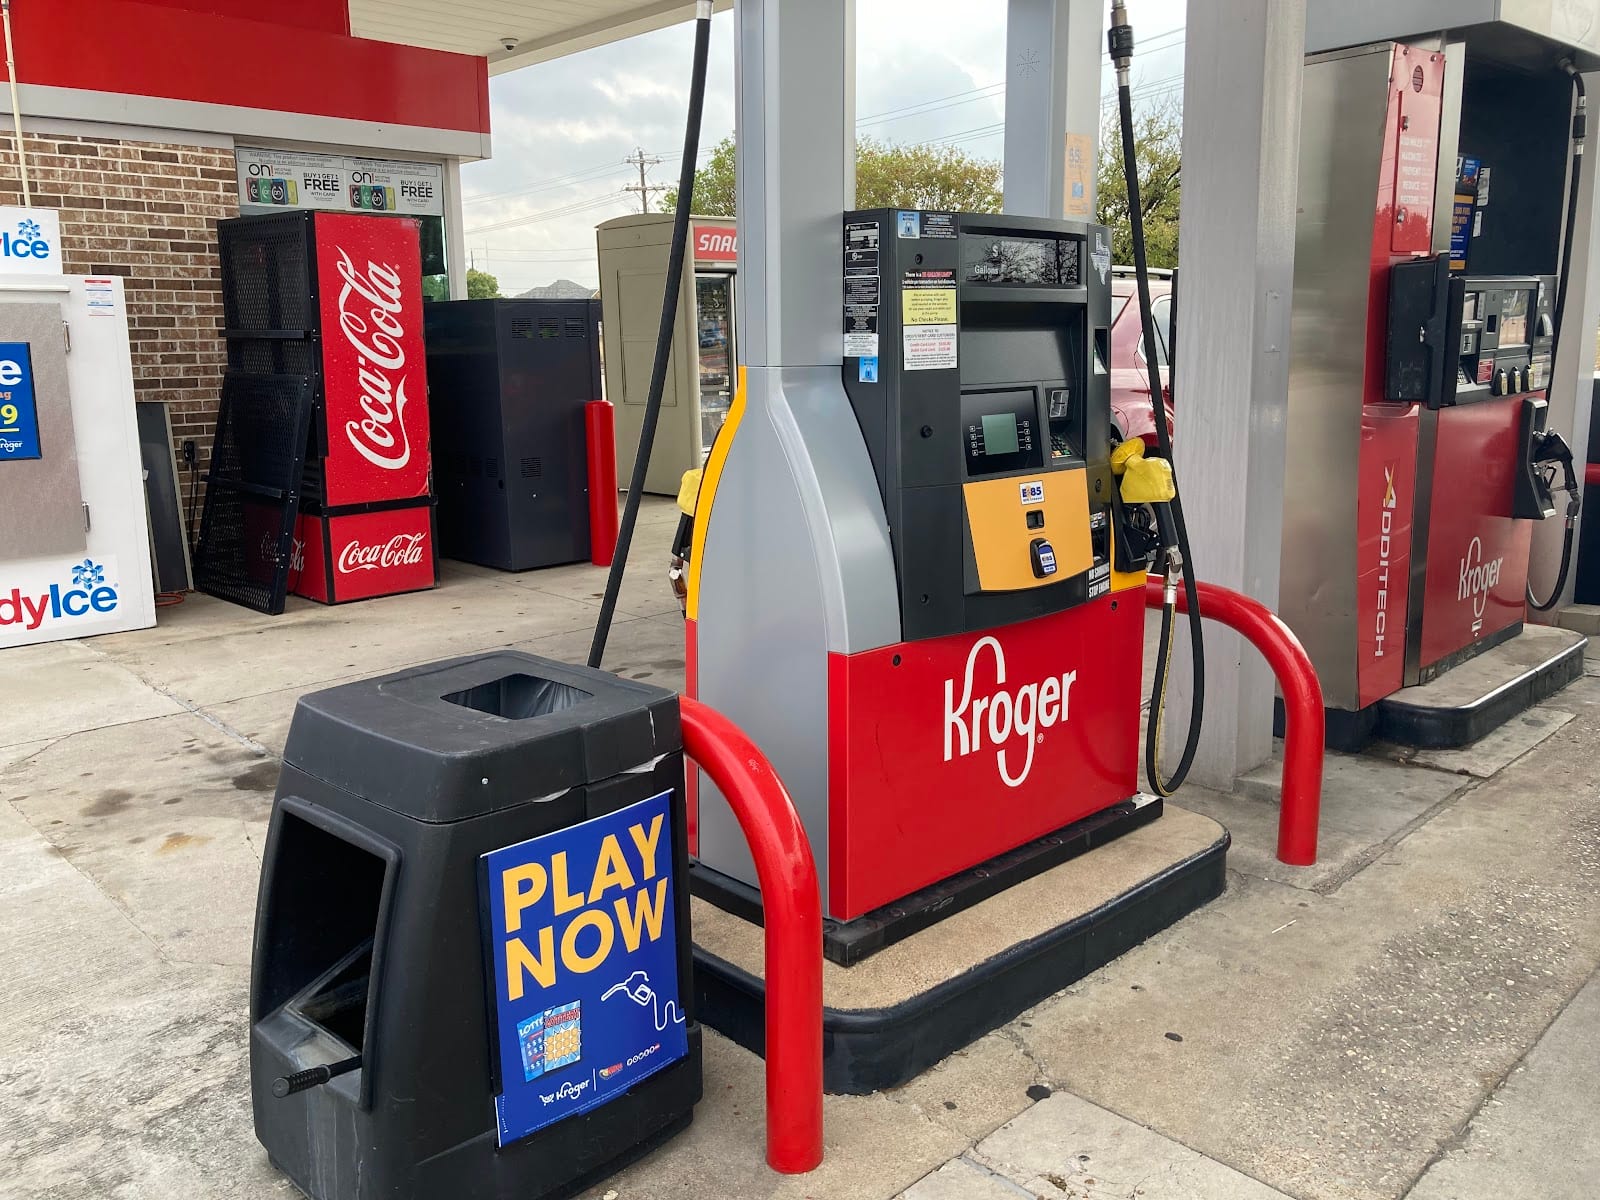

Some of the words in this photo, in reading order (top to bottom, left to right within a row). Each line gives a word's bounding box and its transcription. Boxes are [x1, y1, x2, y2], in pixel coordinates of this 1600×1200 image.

[303, 178, 340, 192] FREE
[401, 186, 433, 198] FREE
[0, 232, 50, 259] Ice
[974, 264, 999, 275] Gallons
[336, 244, 410, 470] Coca-Cola
[0, 438, 23, 453] roger
[338, 531, 427, 574] Coca-Cola
[1374, 464, 1397, 657] ADDITECH
[1088, 584, 1099, 598] STOP
[1098, 578, 1110, 594] ENGINE
[1457, 536, 1504, 618] Kroger
[944, 635, 1077, 788] Kroger
[502, 812, 665, 934] PLAY
[505, 876, 668, 1002] NOW
[556, 1079, 590, 1100] Kroger
